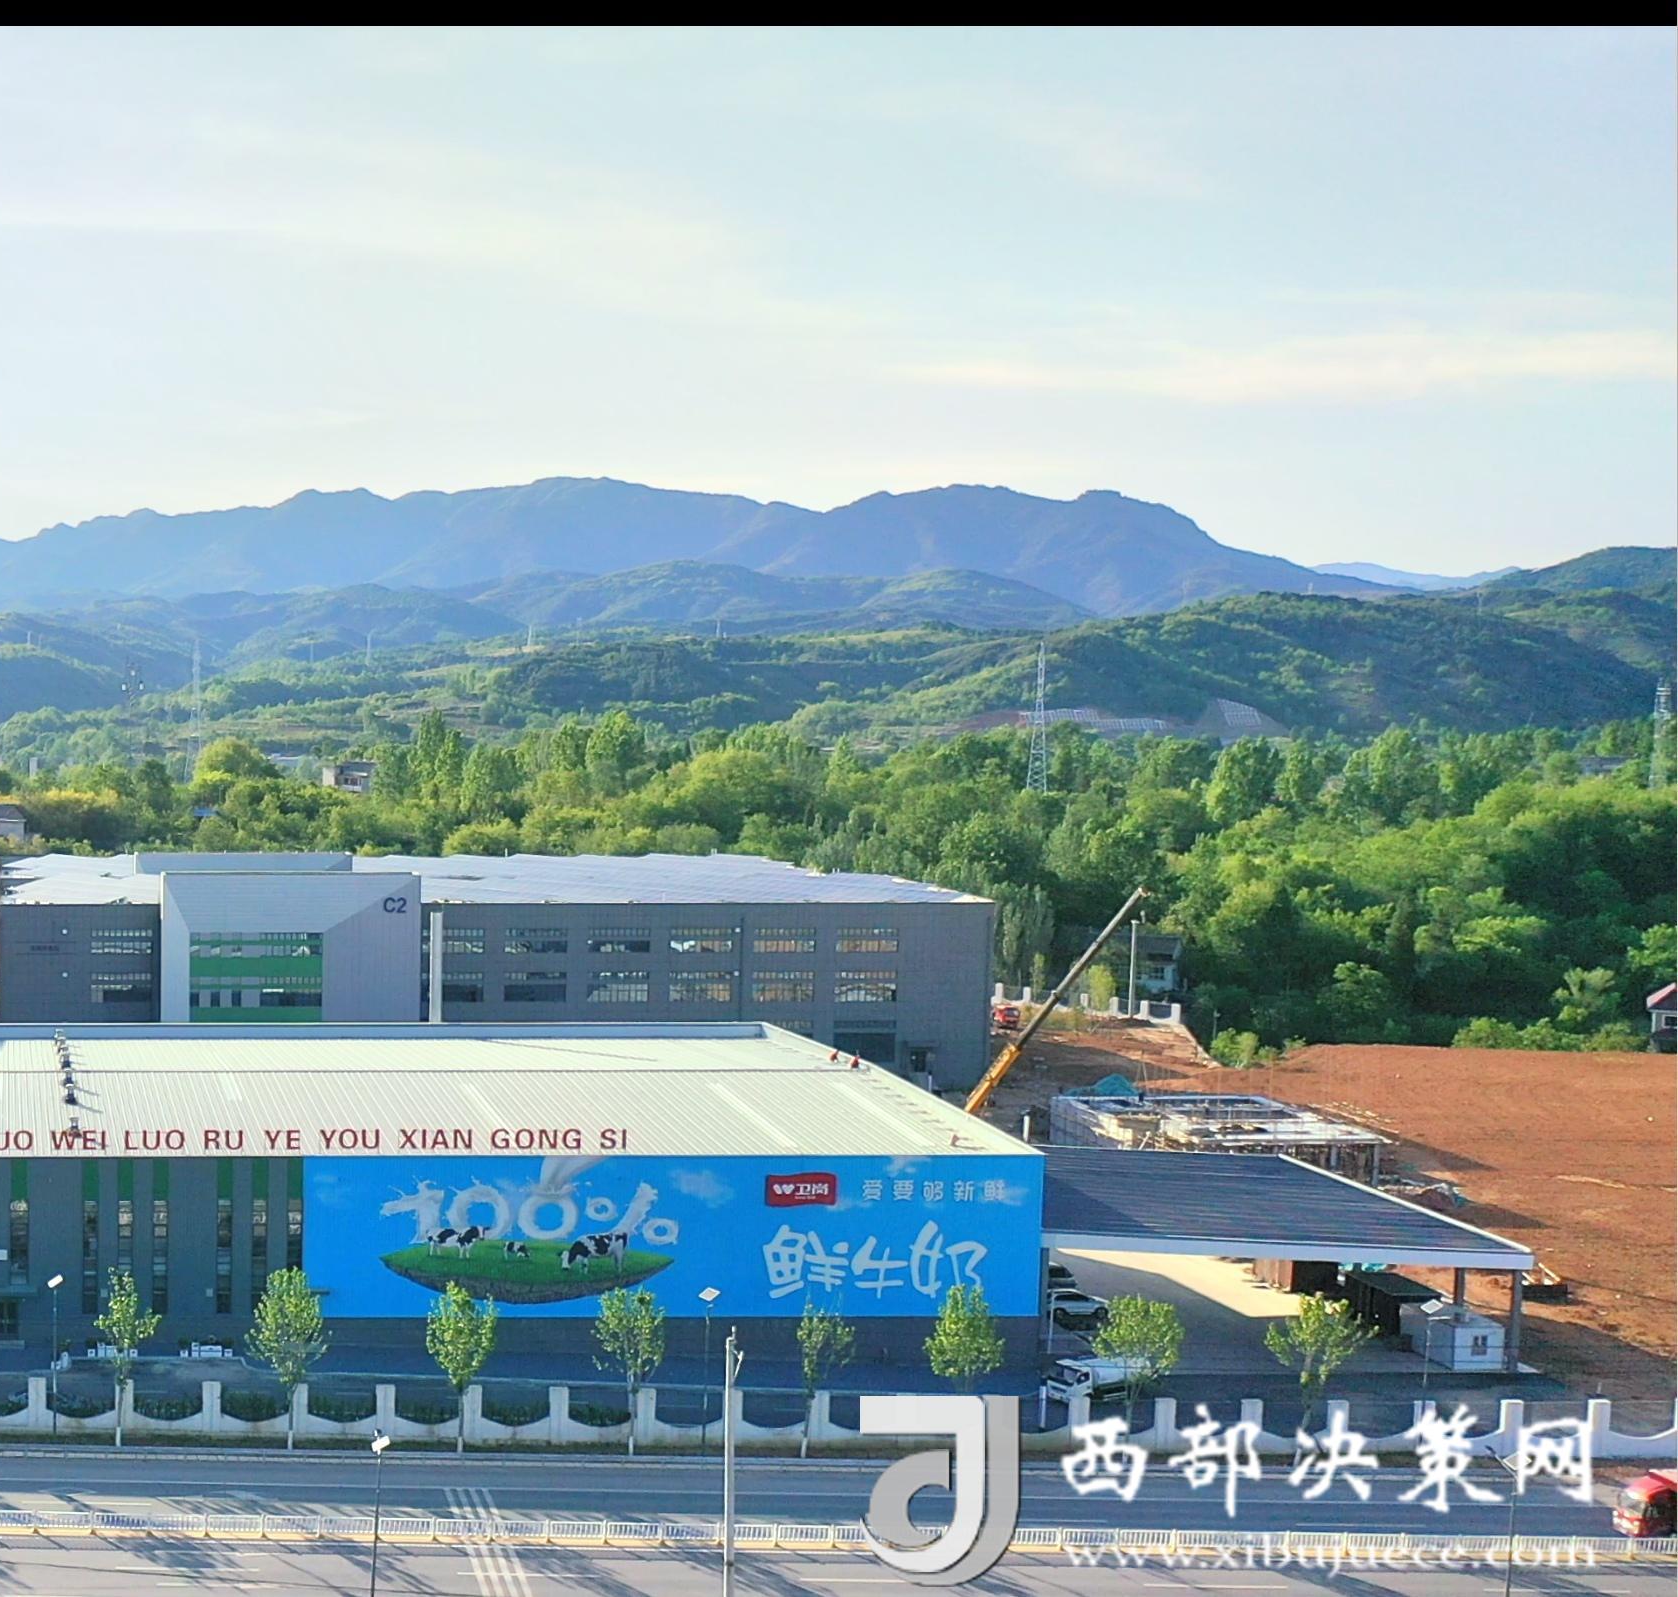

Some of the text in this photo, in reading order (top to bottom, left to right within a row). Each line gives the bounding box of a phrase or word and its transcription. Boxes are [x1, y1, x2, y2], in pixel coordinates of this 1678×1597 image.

[383, 896, 407, 914] C2
[50, 1130, 106, 1150] WEI
[124, 1129, 185, 1150] LUO
[203, 1129, 244, 1150] RU
[265, 1129, 301, 1150] YE
[319, 1128, 381, 1150] YOU
[399, 1128, 472, 1150] XIAN
[490, 1128, 582, 1150] GONG
[600, 1128, 627, 1150] SI
[862, 1179, 1006, 1202] 爱要够新鲜
[379, 1177, 679, 1245] 100%
[763, 1220, 988, 1299] 鲜牛奶
